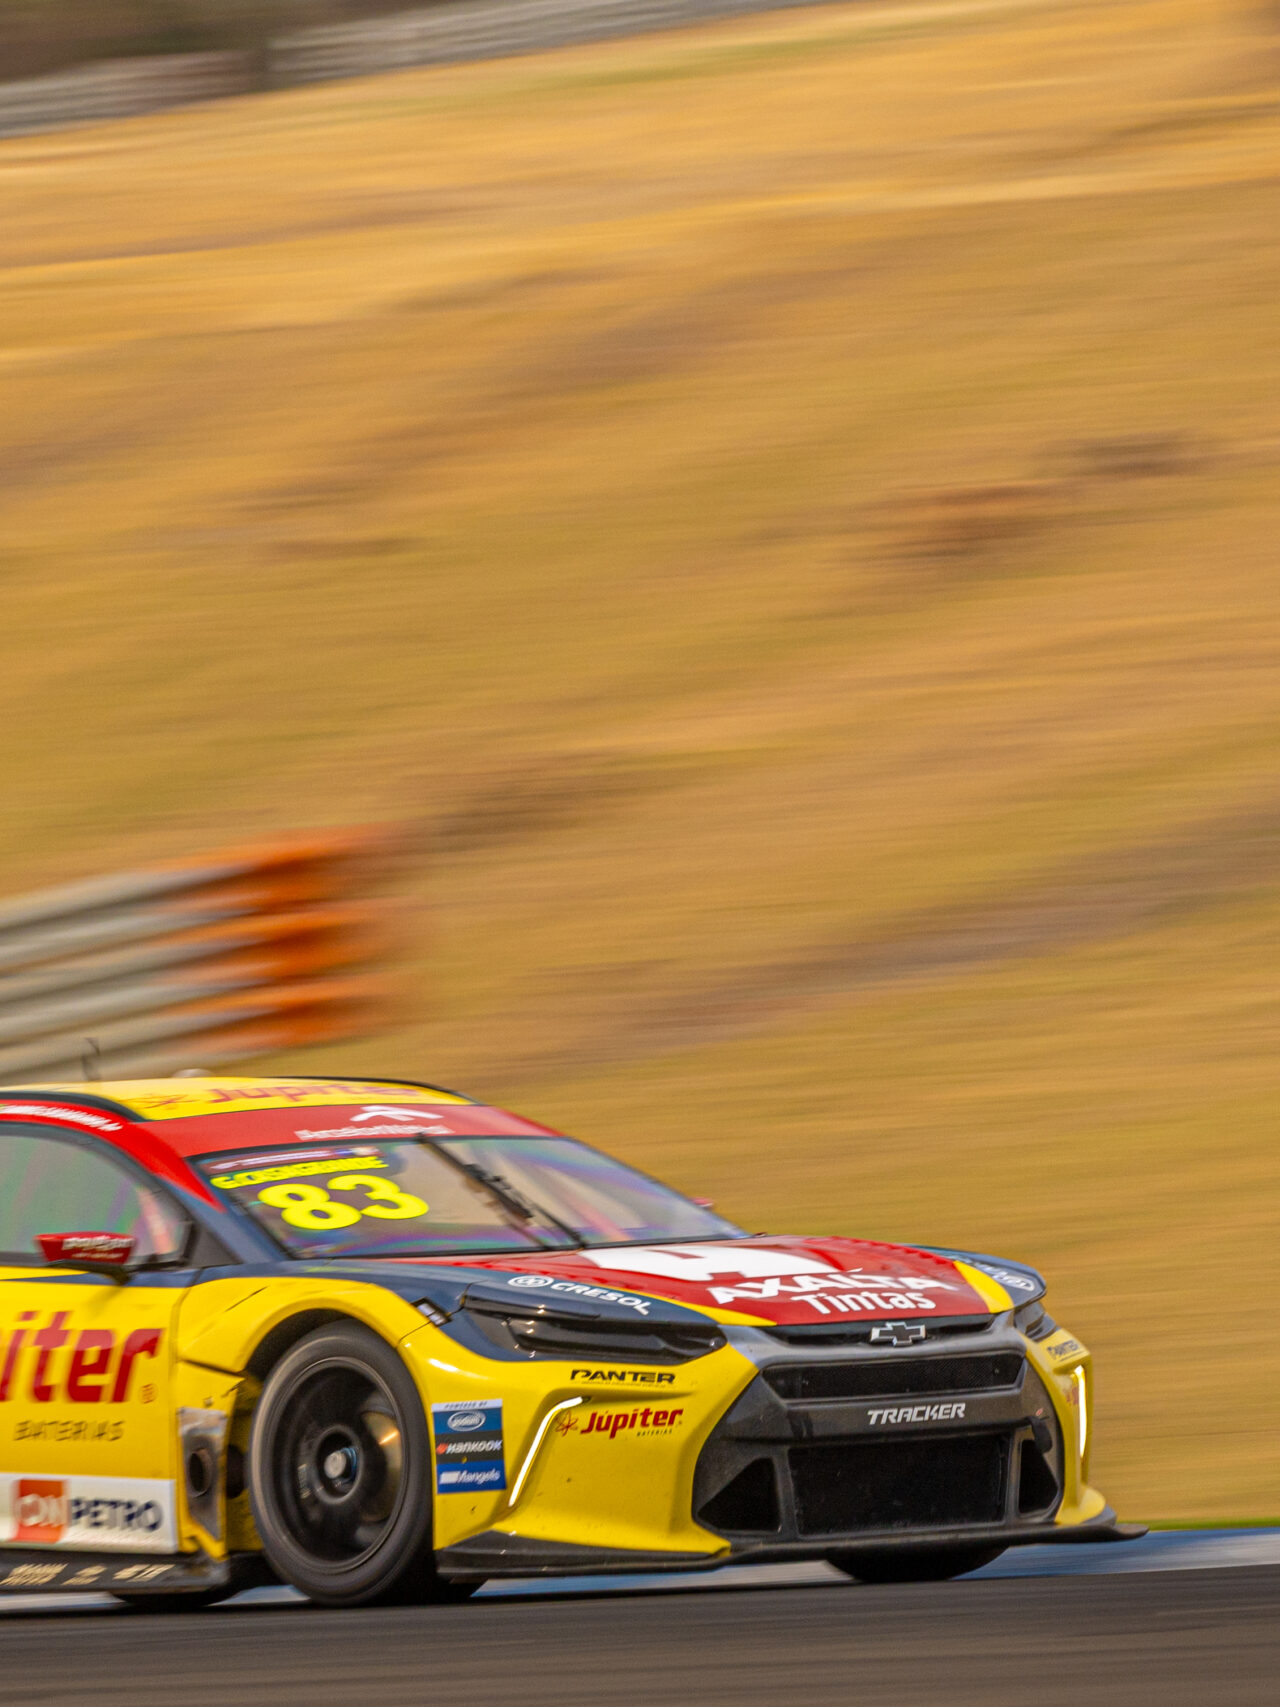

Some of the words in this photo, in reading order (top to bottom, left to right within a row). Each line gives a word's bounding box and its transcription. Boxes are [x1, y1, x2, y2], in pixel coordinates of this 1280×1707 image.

[258, 1174, 428, 1230] 83
[551, 1282, 651, 1315] CRESOL
[707, 1268, 959, 1304] AXALTA
[791, 1291, 936, 1314] Tintas
[570, 1369, 676, 1383] PANTER
[580, 1408, 683, 1439] Júpiter
[867, 1402, 966, 1425] TRACKER
[69, 1496, 165, 1532] PETRO
